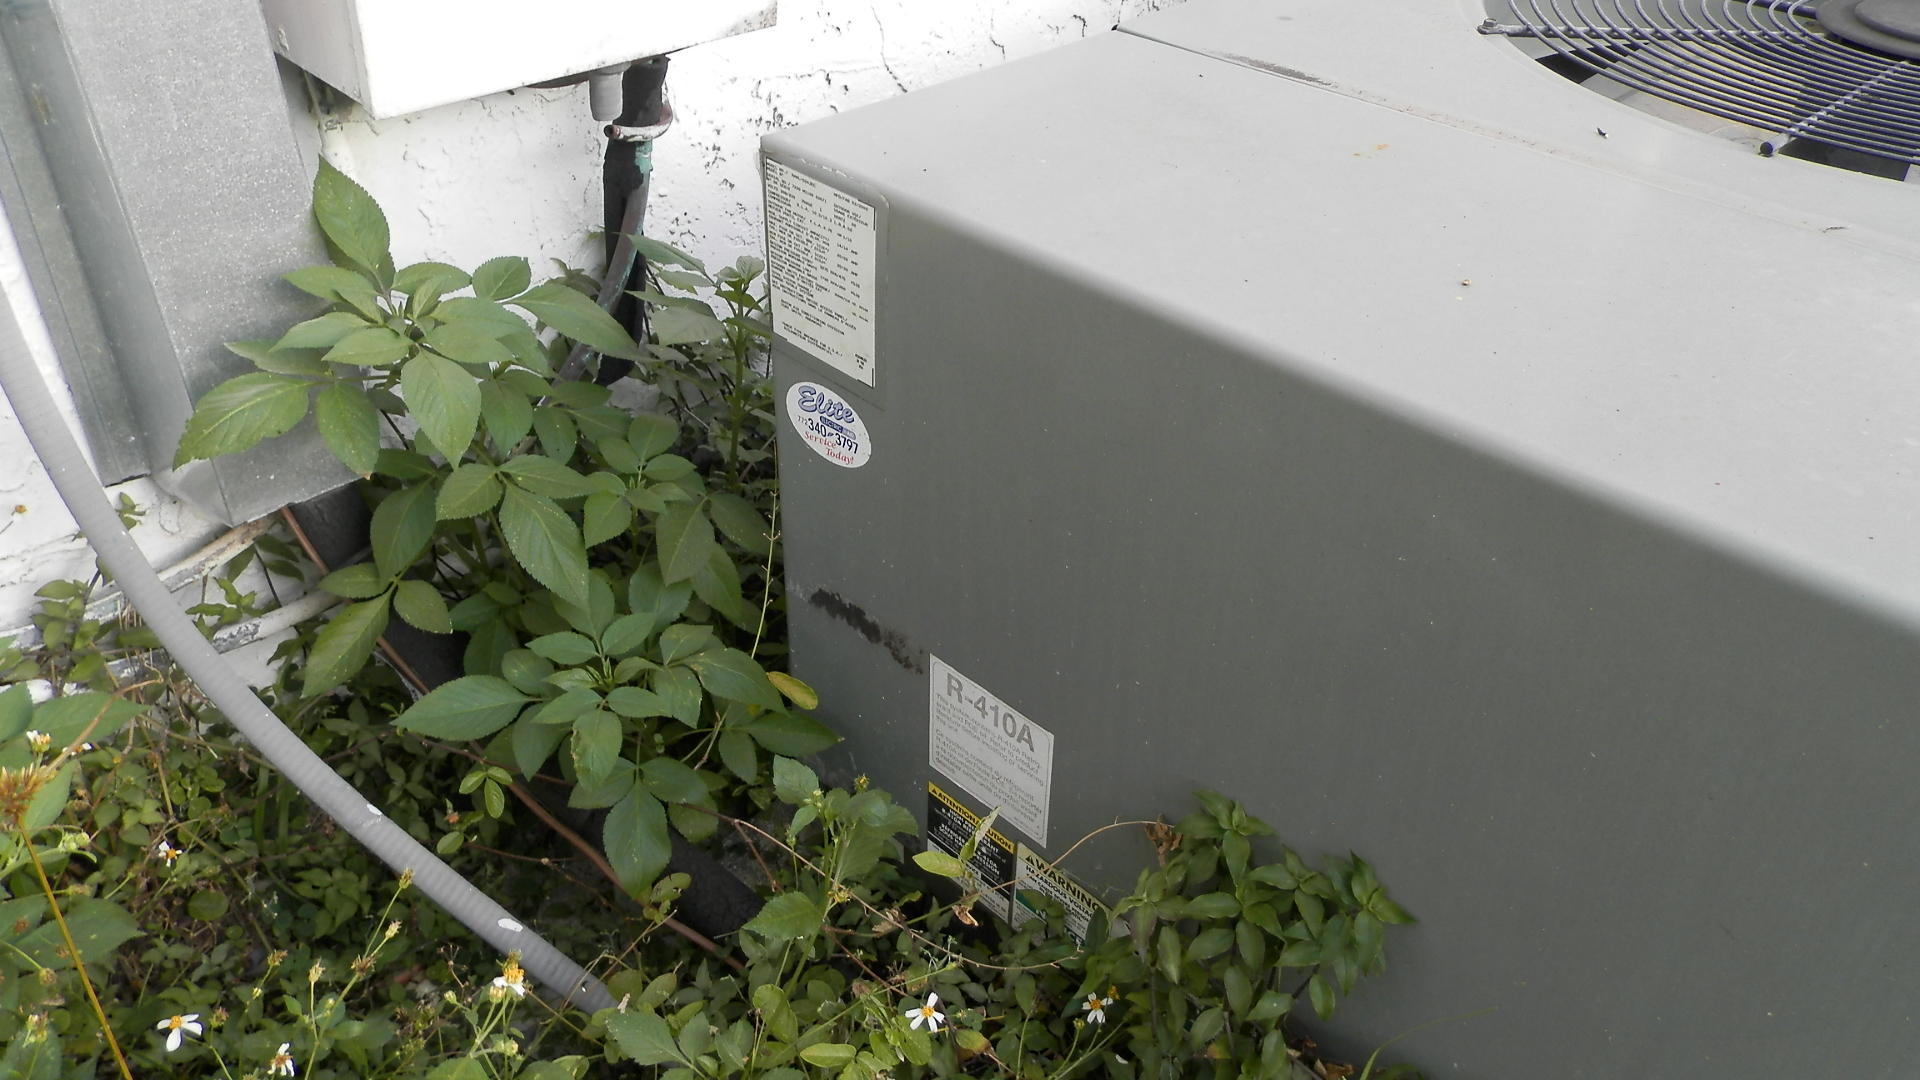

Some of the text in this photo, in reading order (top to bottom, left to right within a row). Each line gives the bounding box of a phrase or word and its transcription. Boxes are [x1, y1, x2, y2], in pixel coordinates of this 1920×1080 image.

[798, 385, 855, 423] Elite
[804, 431, 837, 449] Service
[808, 418, 827, 438] 340
[835, 432, 859, 455] 3797
[826, 447, 855, 466] Today!
[947, 672, 1035, 752] R-410A
